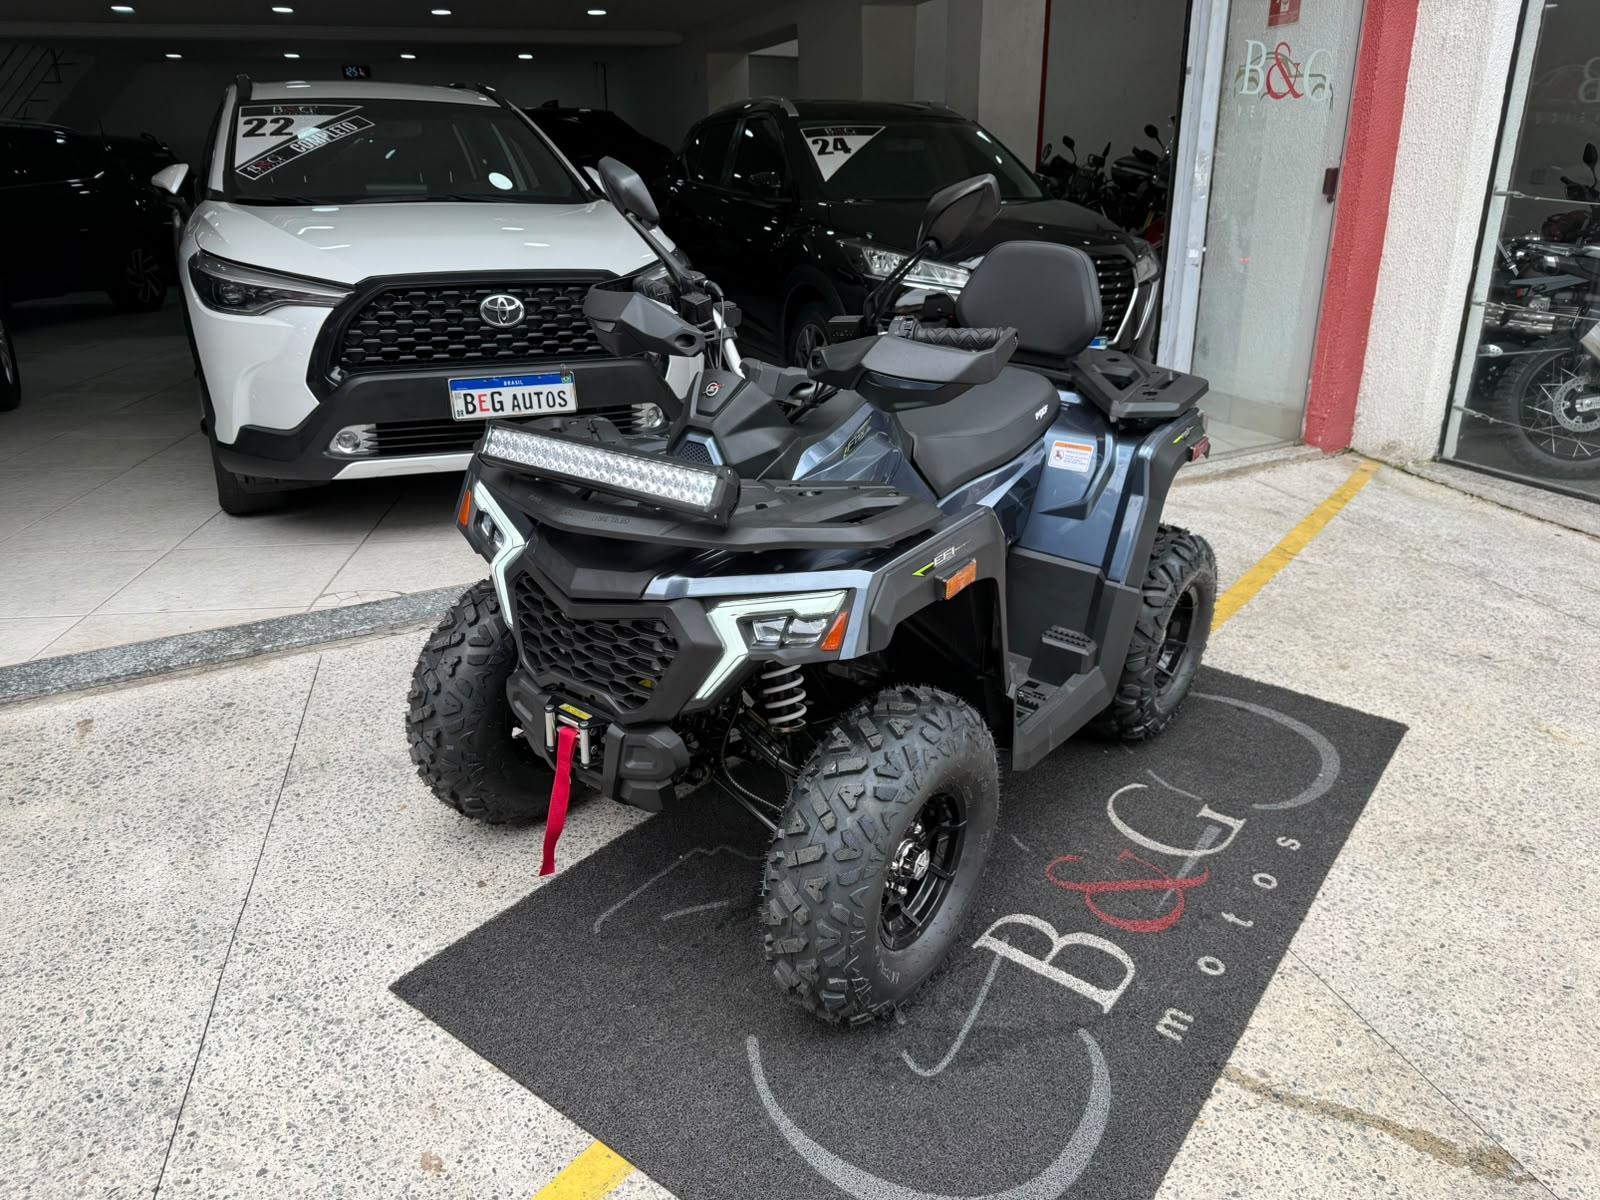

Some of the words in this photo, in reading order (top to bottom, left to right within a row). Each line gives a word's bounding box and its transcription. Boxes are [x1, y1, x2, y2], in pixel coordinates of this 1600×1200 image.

[242, 117, 294, 138] 22
[290, 121, 358, 153] COMPLETO
[812, 137, 851, 155] 24
[463, 391, 504, 415] BEG
[512, 390, 568, 411] AUTOS
